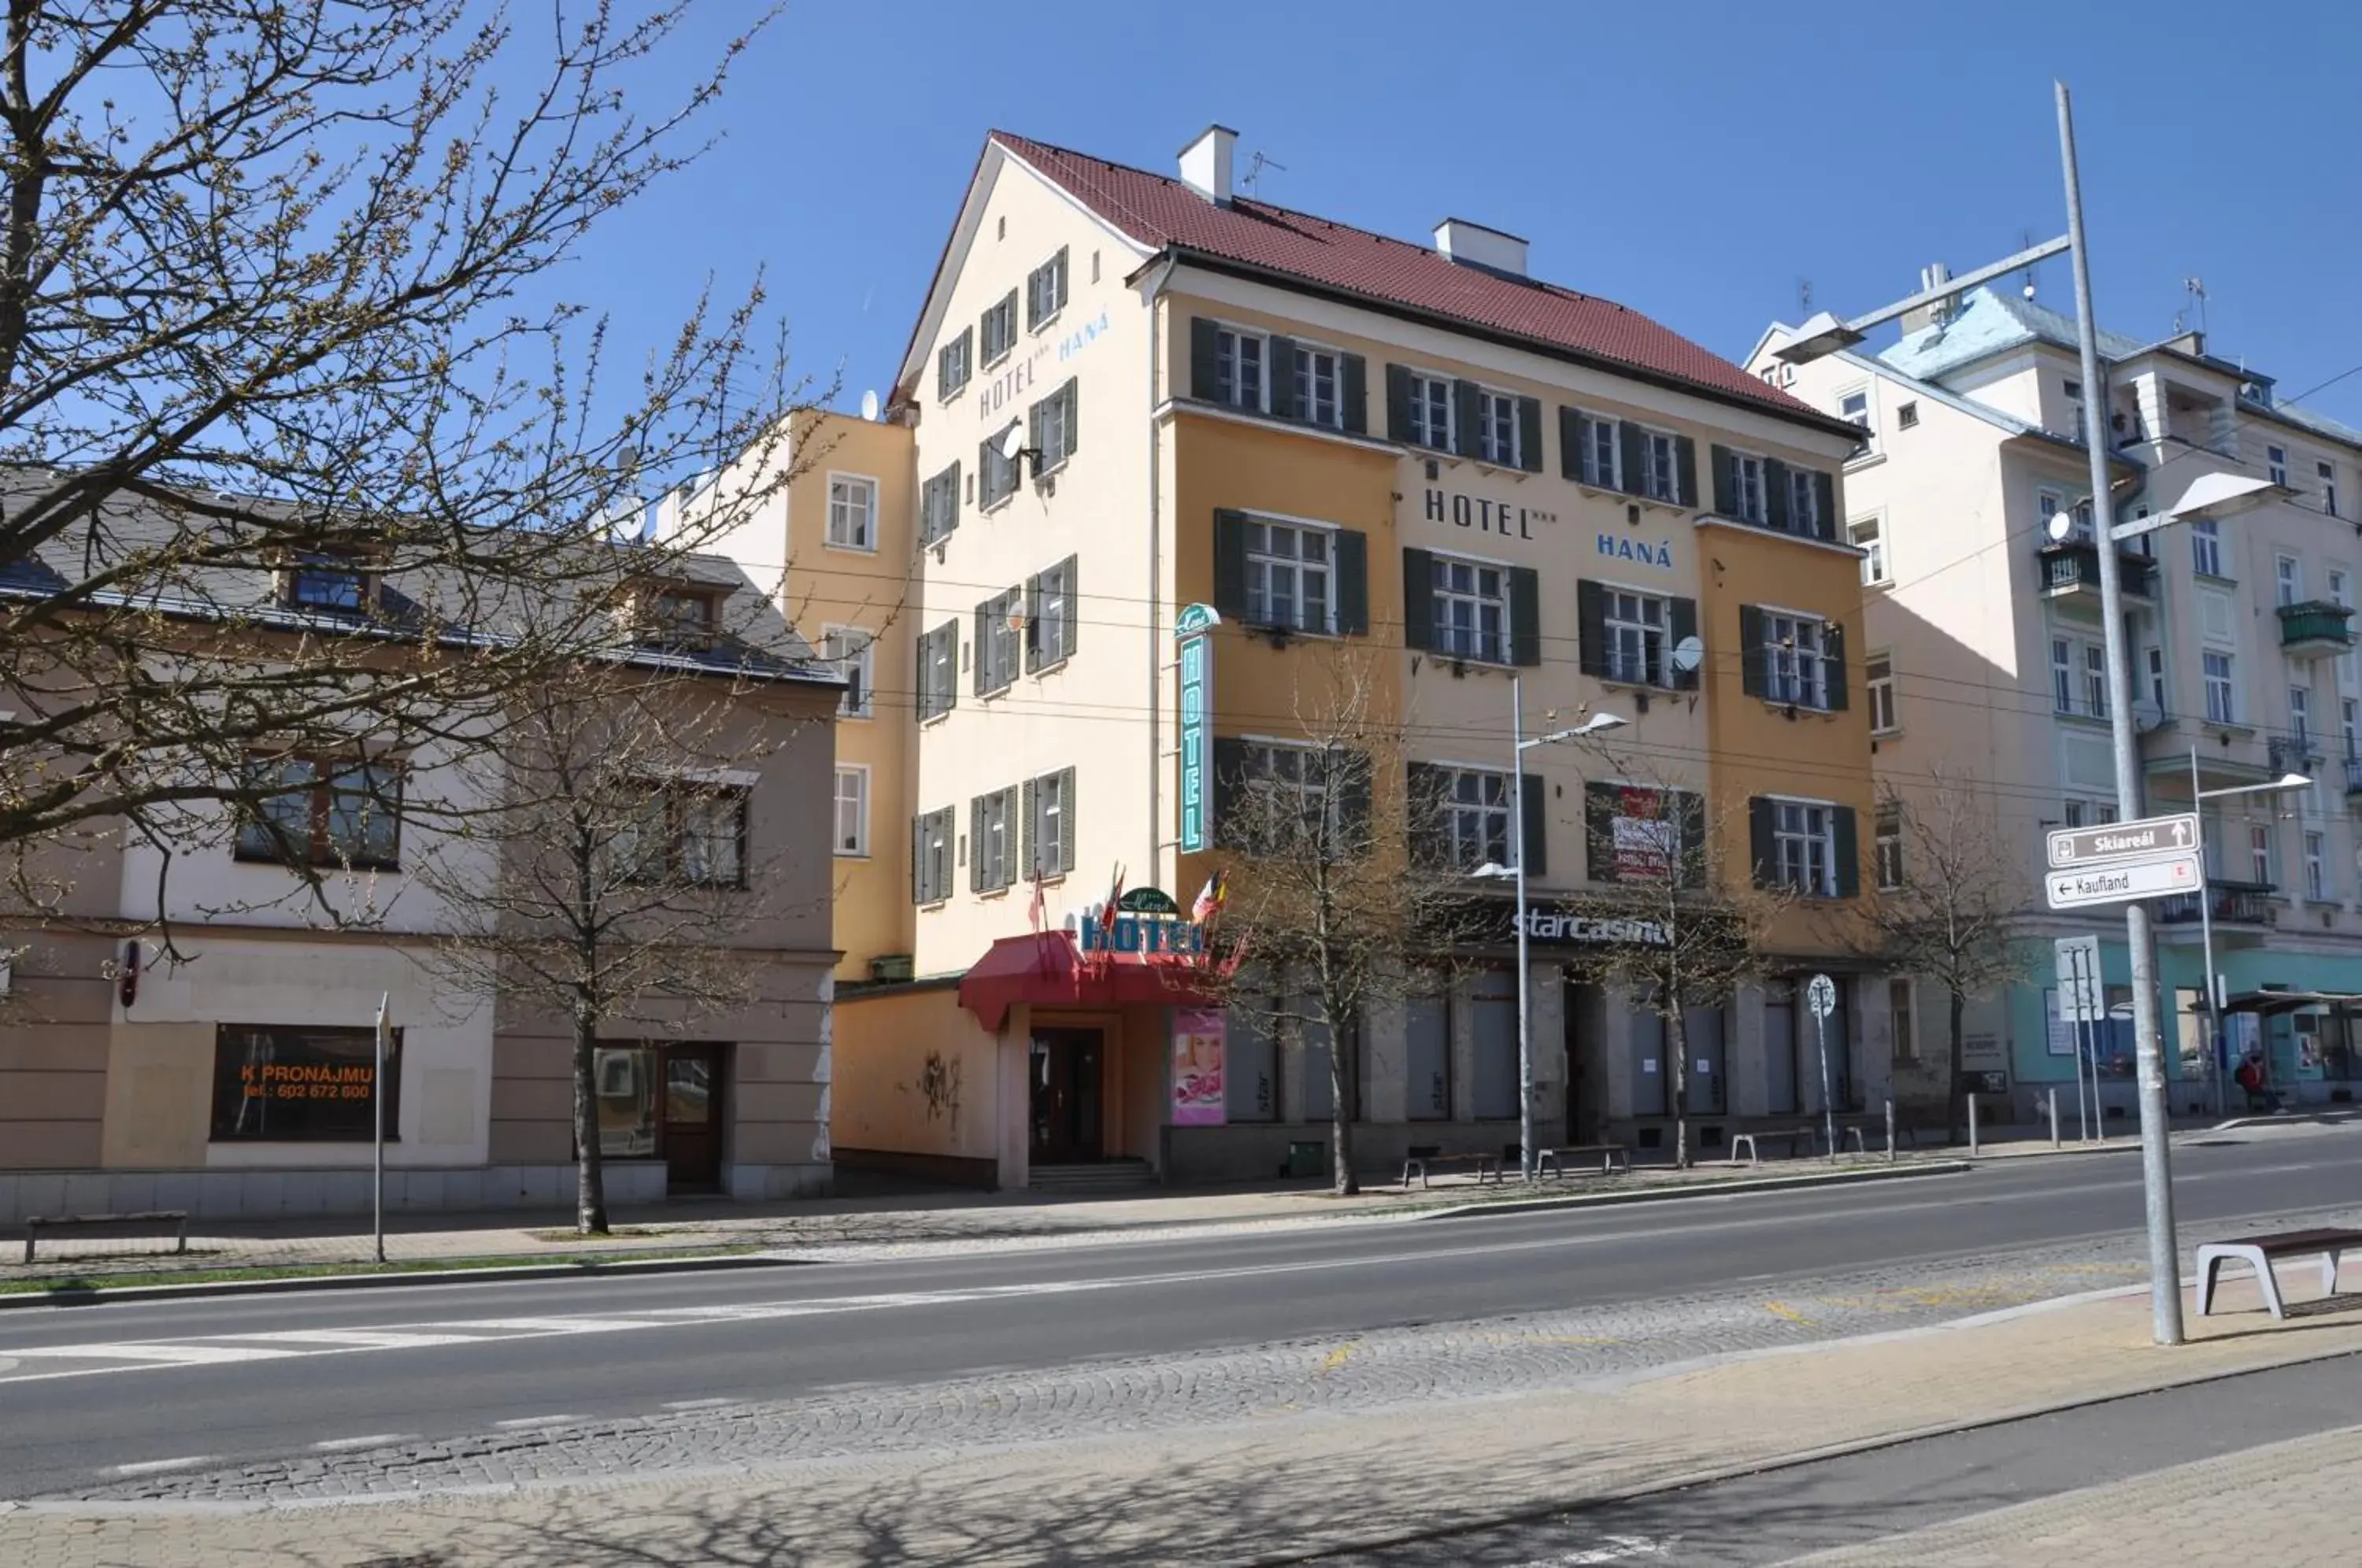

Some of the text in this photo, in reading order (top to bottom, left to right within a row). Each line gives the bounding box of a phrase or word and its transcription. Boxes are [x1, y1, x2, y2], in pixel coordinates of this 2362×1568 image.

[980, 357, 1035, 420] HOTEL
[1426, 489, 1533, 540] HOTEL
[1597, 534, 1672, 568] HANÁ
[1183, 644, 1201, 847] HOTEL
[2094, 830, 2155, 852] Skiareál
[2075, 873, 2130, 895] Kaufland
[241, 1063, 373, 1083] K PRONÁJMU
